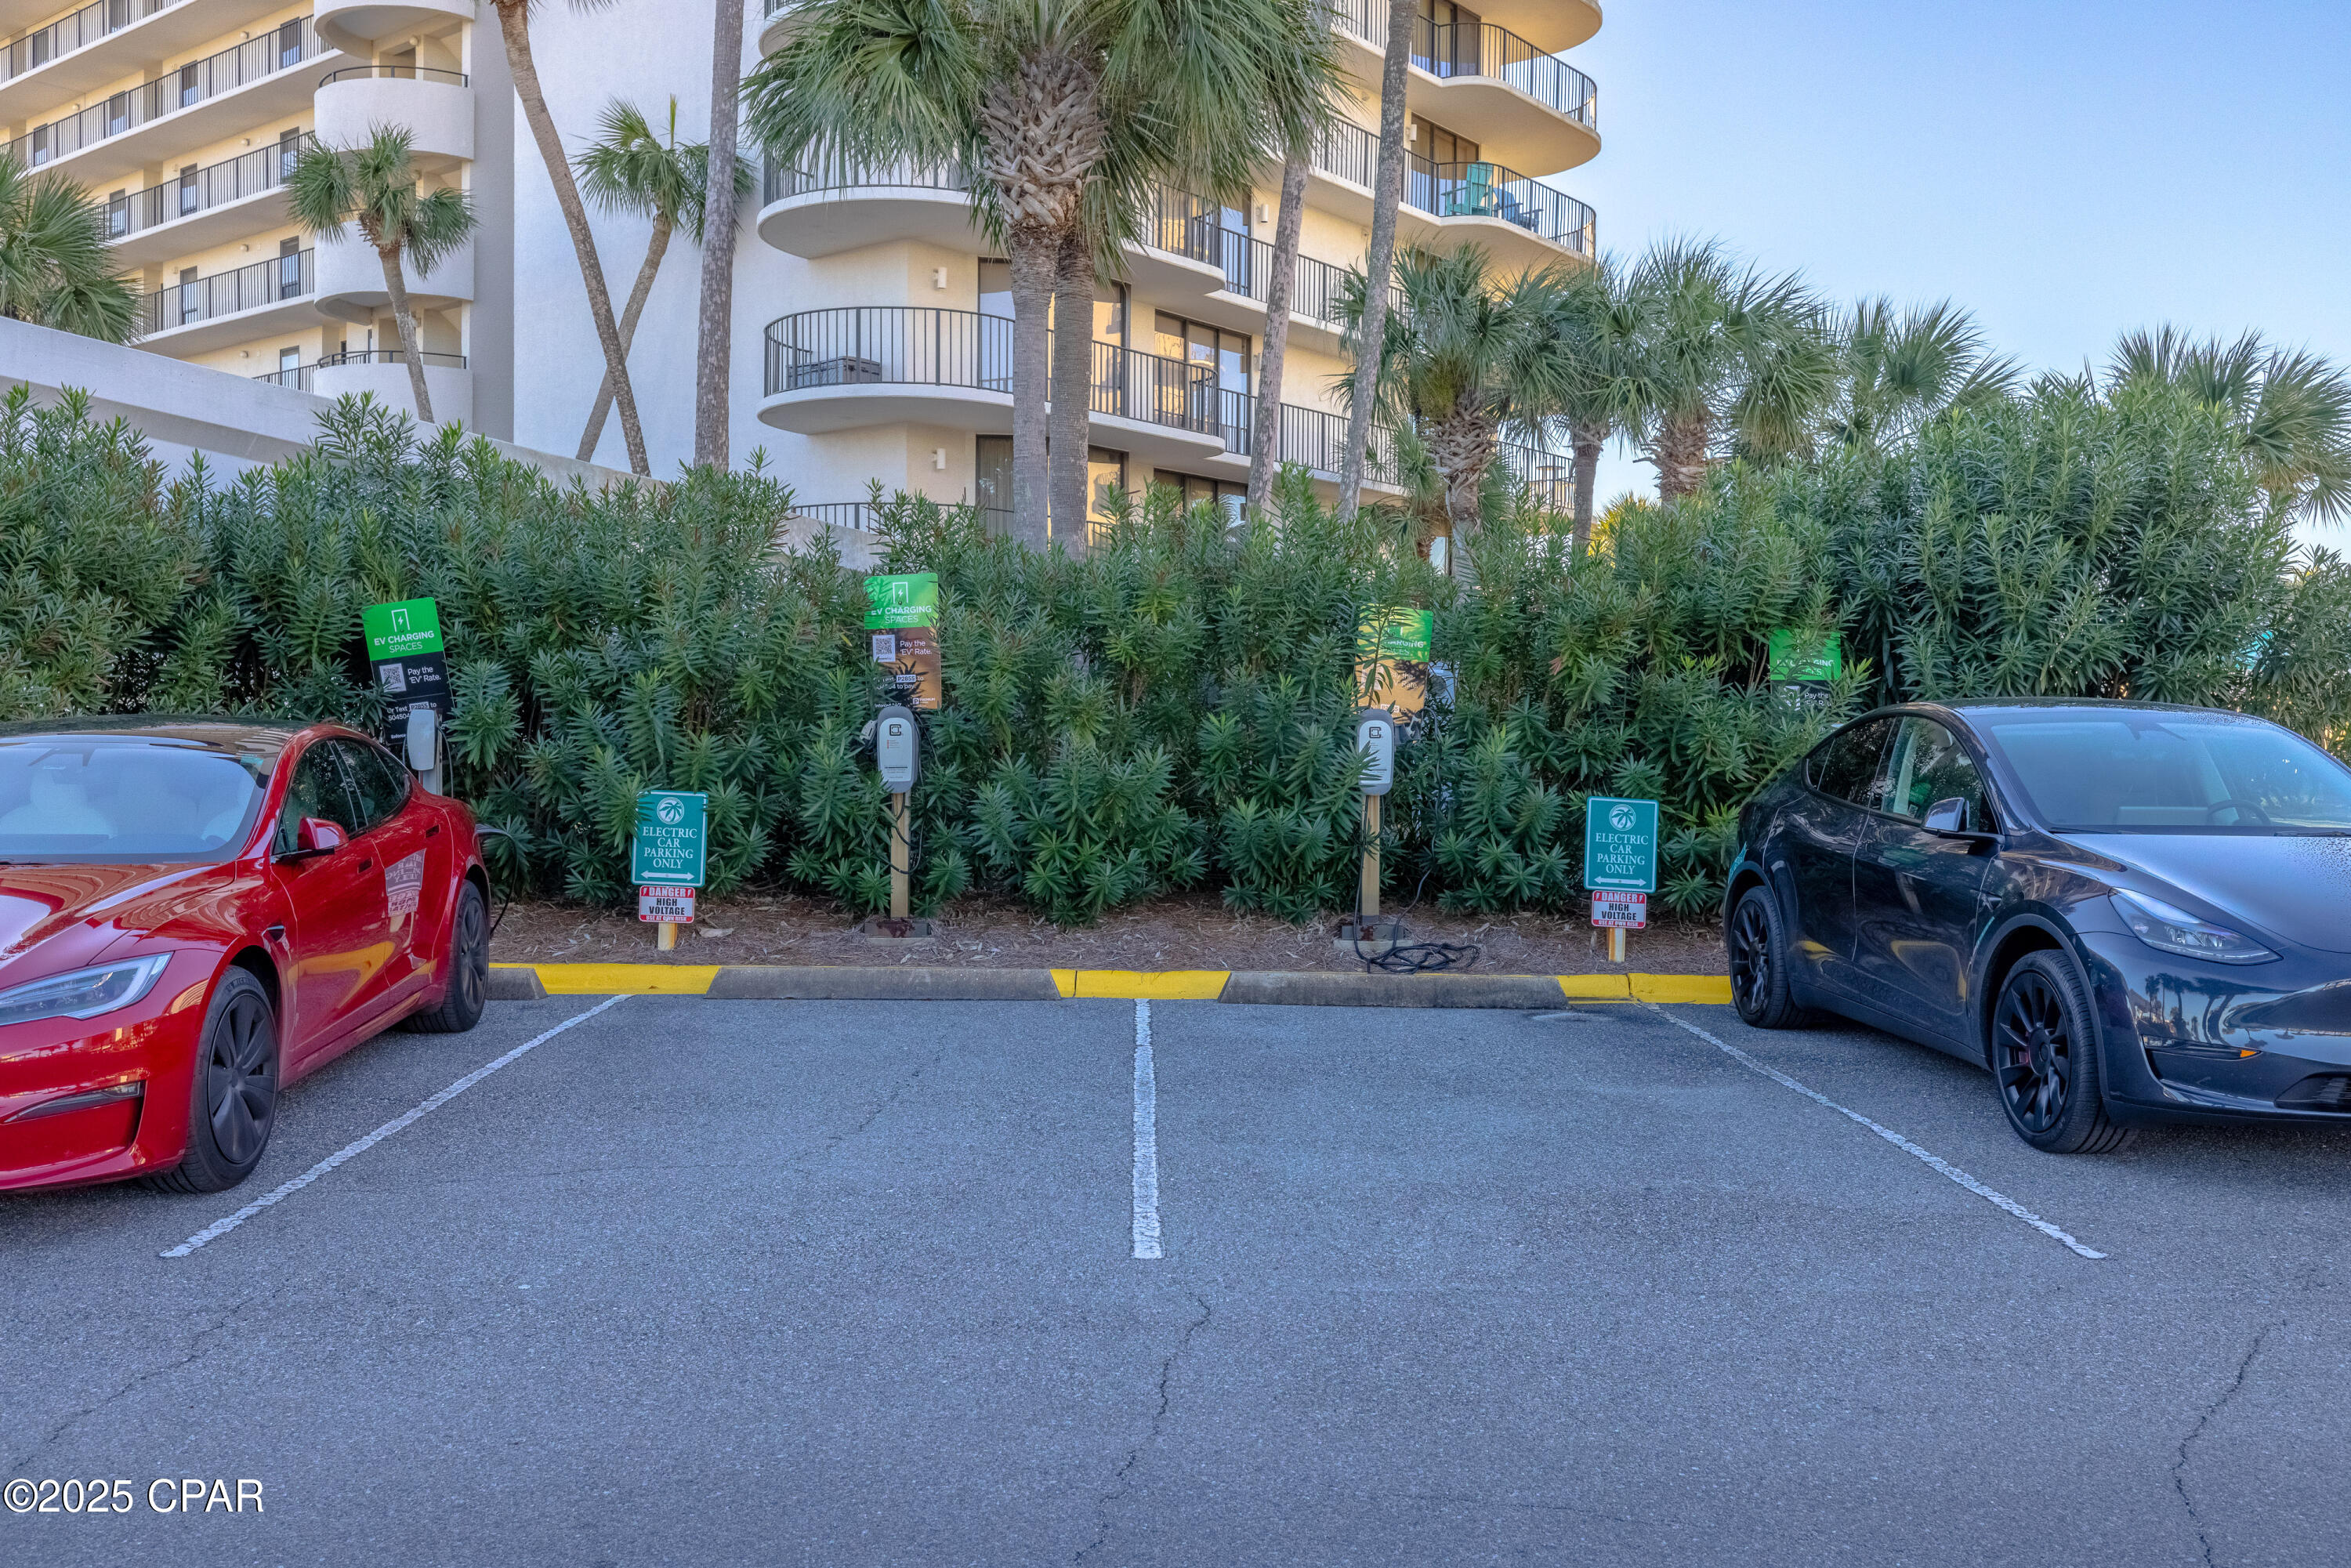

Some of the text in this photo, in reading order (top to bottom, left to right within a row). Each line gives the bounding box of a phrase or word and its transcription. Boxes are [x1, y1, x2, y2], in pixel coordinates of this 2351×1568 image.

[885, 605, 932, 615] CHARGING
[885, 615, 918, 624] SPACES
[374, 630, 435, 646] EV CHARGING
[389, 642, 423, 653] SPACES
[408, 668, 420, 677] Pay
[424, 674, 441, 682] Rate.
[642, 826, 697, 838] ELECTRIC
[657, 837, 681, 848] CAR
[1596, 833, 1648, 845] ELECTRIC
[644, 847, 694, 859] PARKING
[1610, 844, 1632, 854] CAR
[653, 858, 684, 869] ONLY
[1597, 853, 1645, 865] PARKING
[1606, 864, 1636, 875] ONLY
[649, 887, 686, 897] DANGER
[656, 898, 677, 906] HIGH
[1601, 892, 1637, 903] DANGER
[648, 906, 685, 915] VOLTAGE
[1608, 903, 1629, 911] HIGH
[1601, 911, 1637, 920] VOLTAGE
